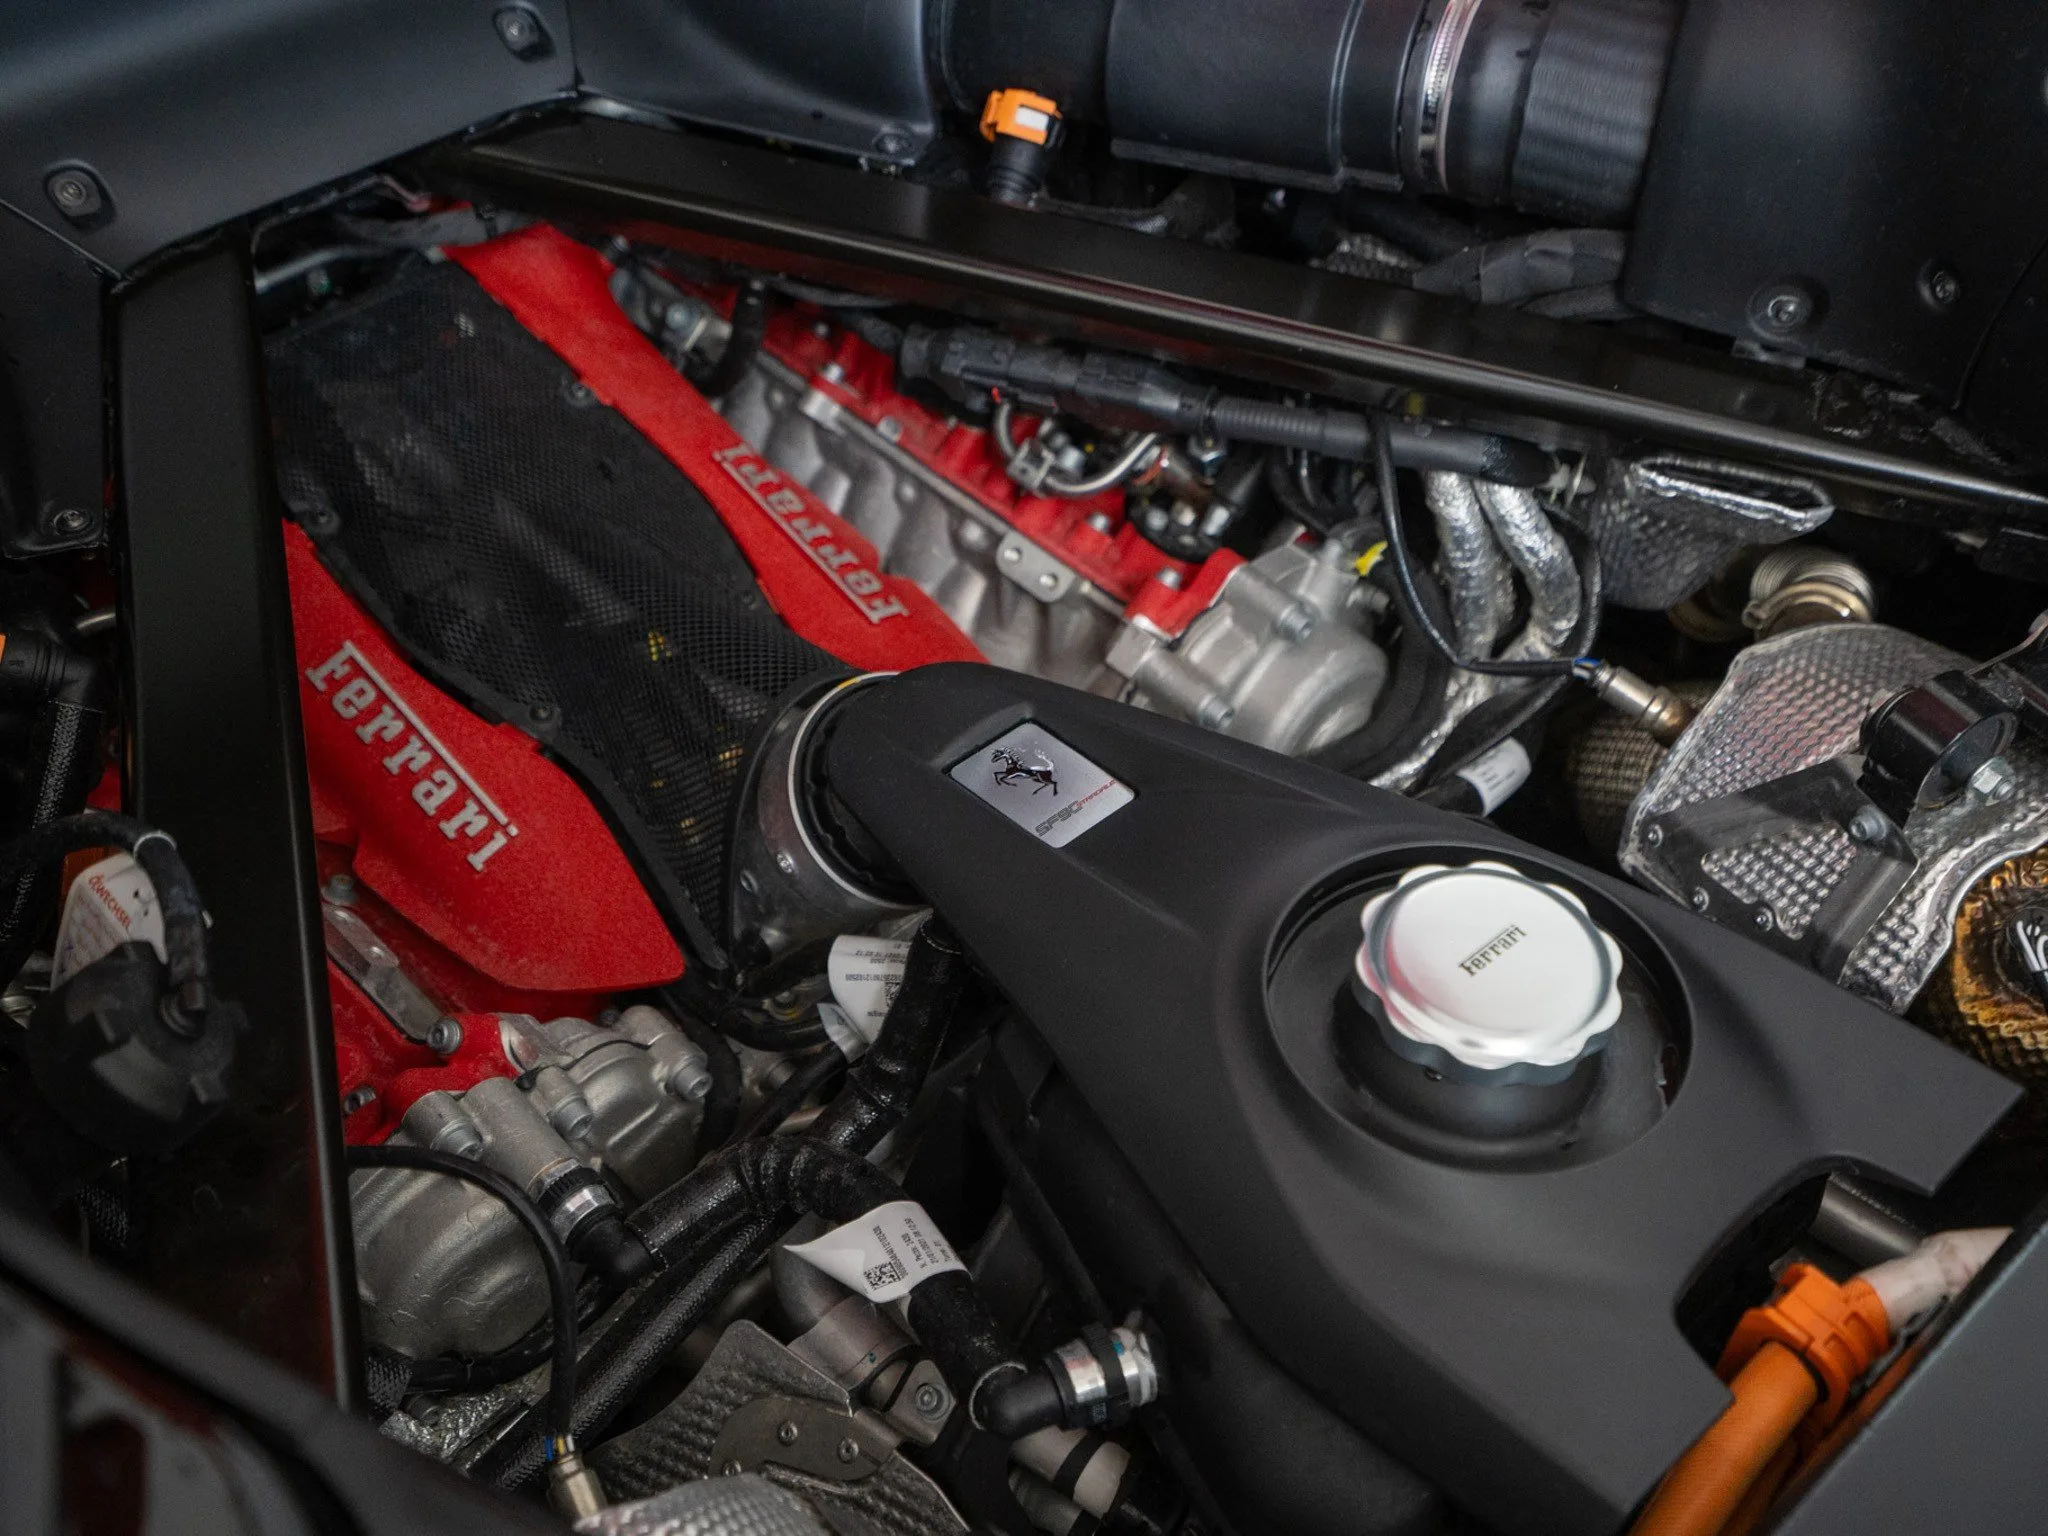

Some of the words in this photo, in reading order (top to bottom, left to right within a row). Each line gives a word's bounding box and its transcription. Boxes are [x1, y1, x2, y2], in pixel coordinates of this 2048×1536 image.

[712, 444, 909, 623] Ferrari
[305, 640, 519, 872] Ferrari
[1034, 800, 1083, 837] SF90
[1457, 924, 1527, 977] Ferrari
